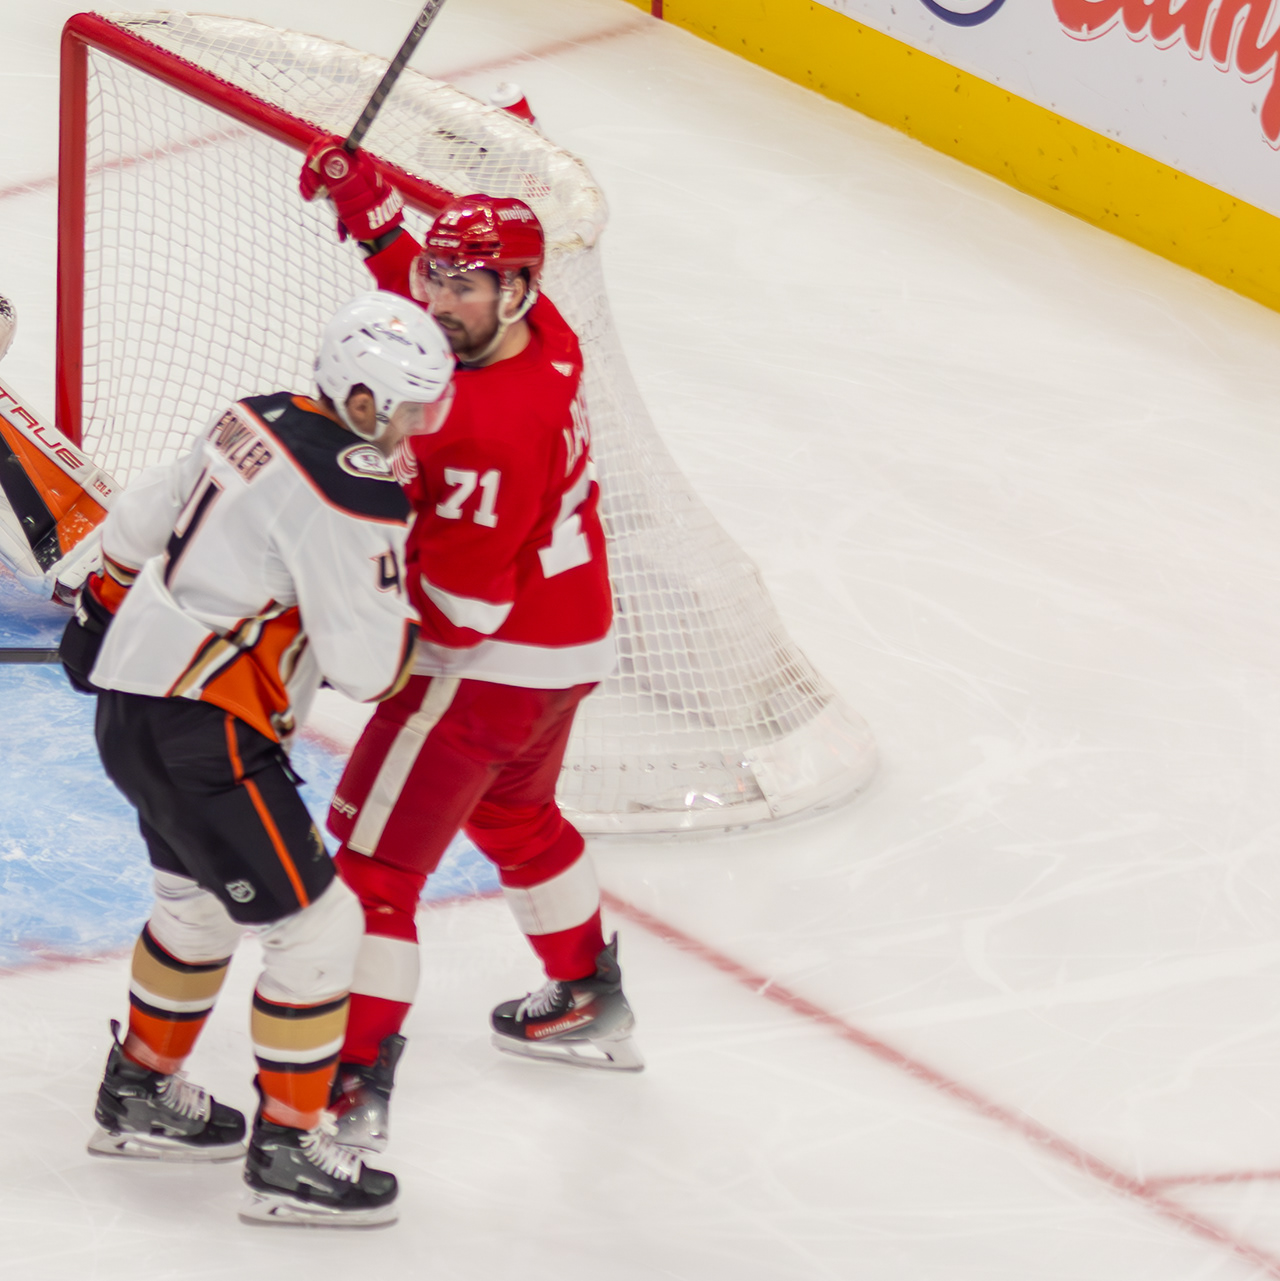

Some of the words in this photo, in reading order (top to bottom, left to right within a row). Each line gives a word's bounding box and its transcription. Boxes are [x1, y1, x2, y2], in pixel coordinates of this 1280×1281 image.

[496, 206, 535, 223] meijer
[207, 408, 274, 485] FOWLER
[435, 468, 502, 528] 71
